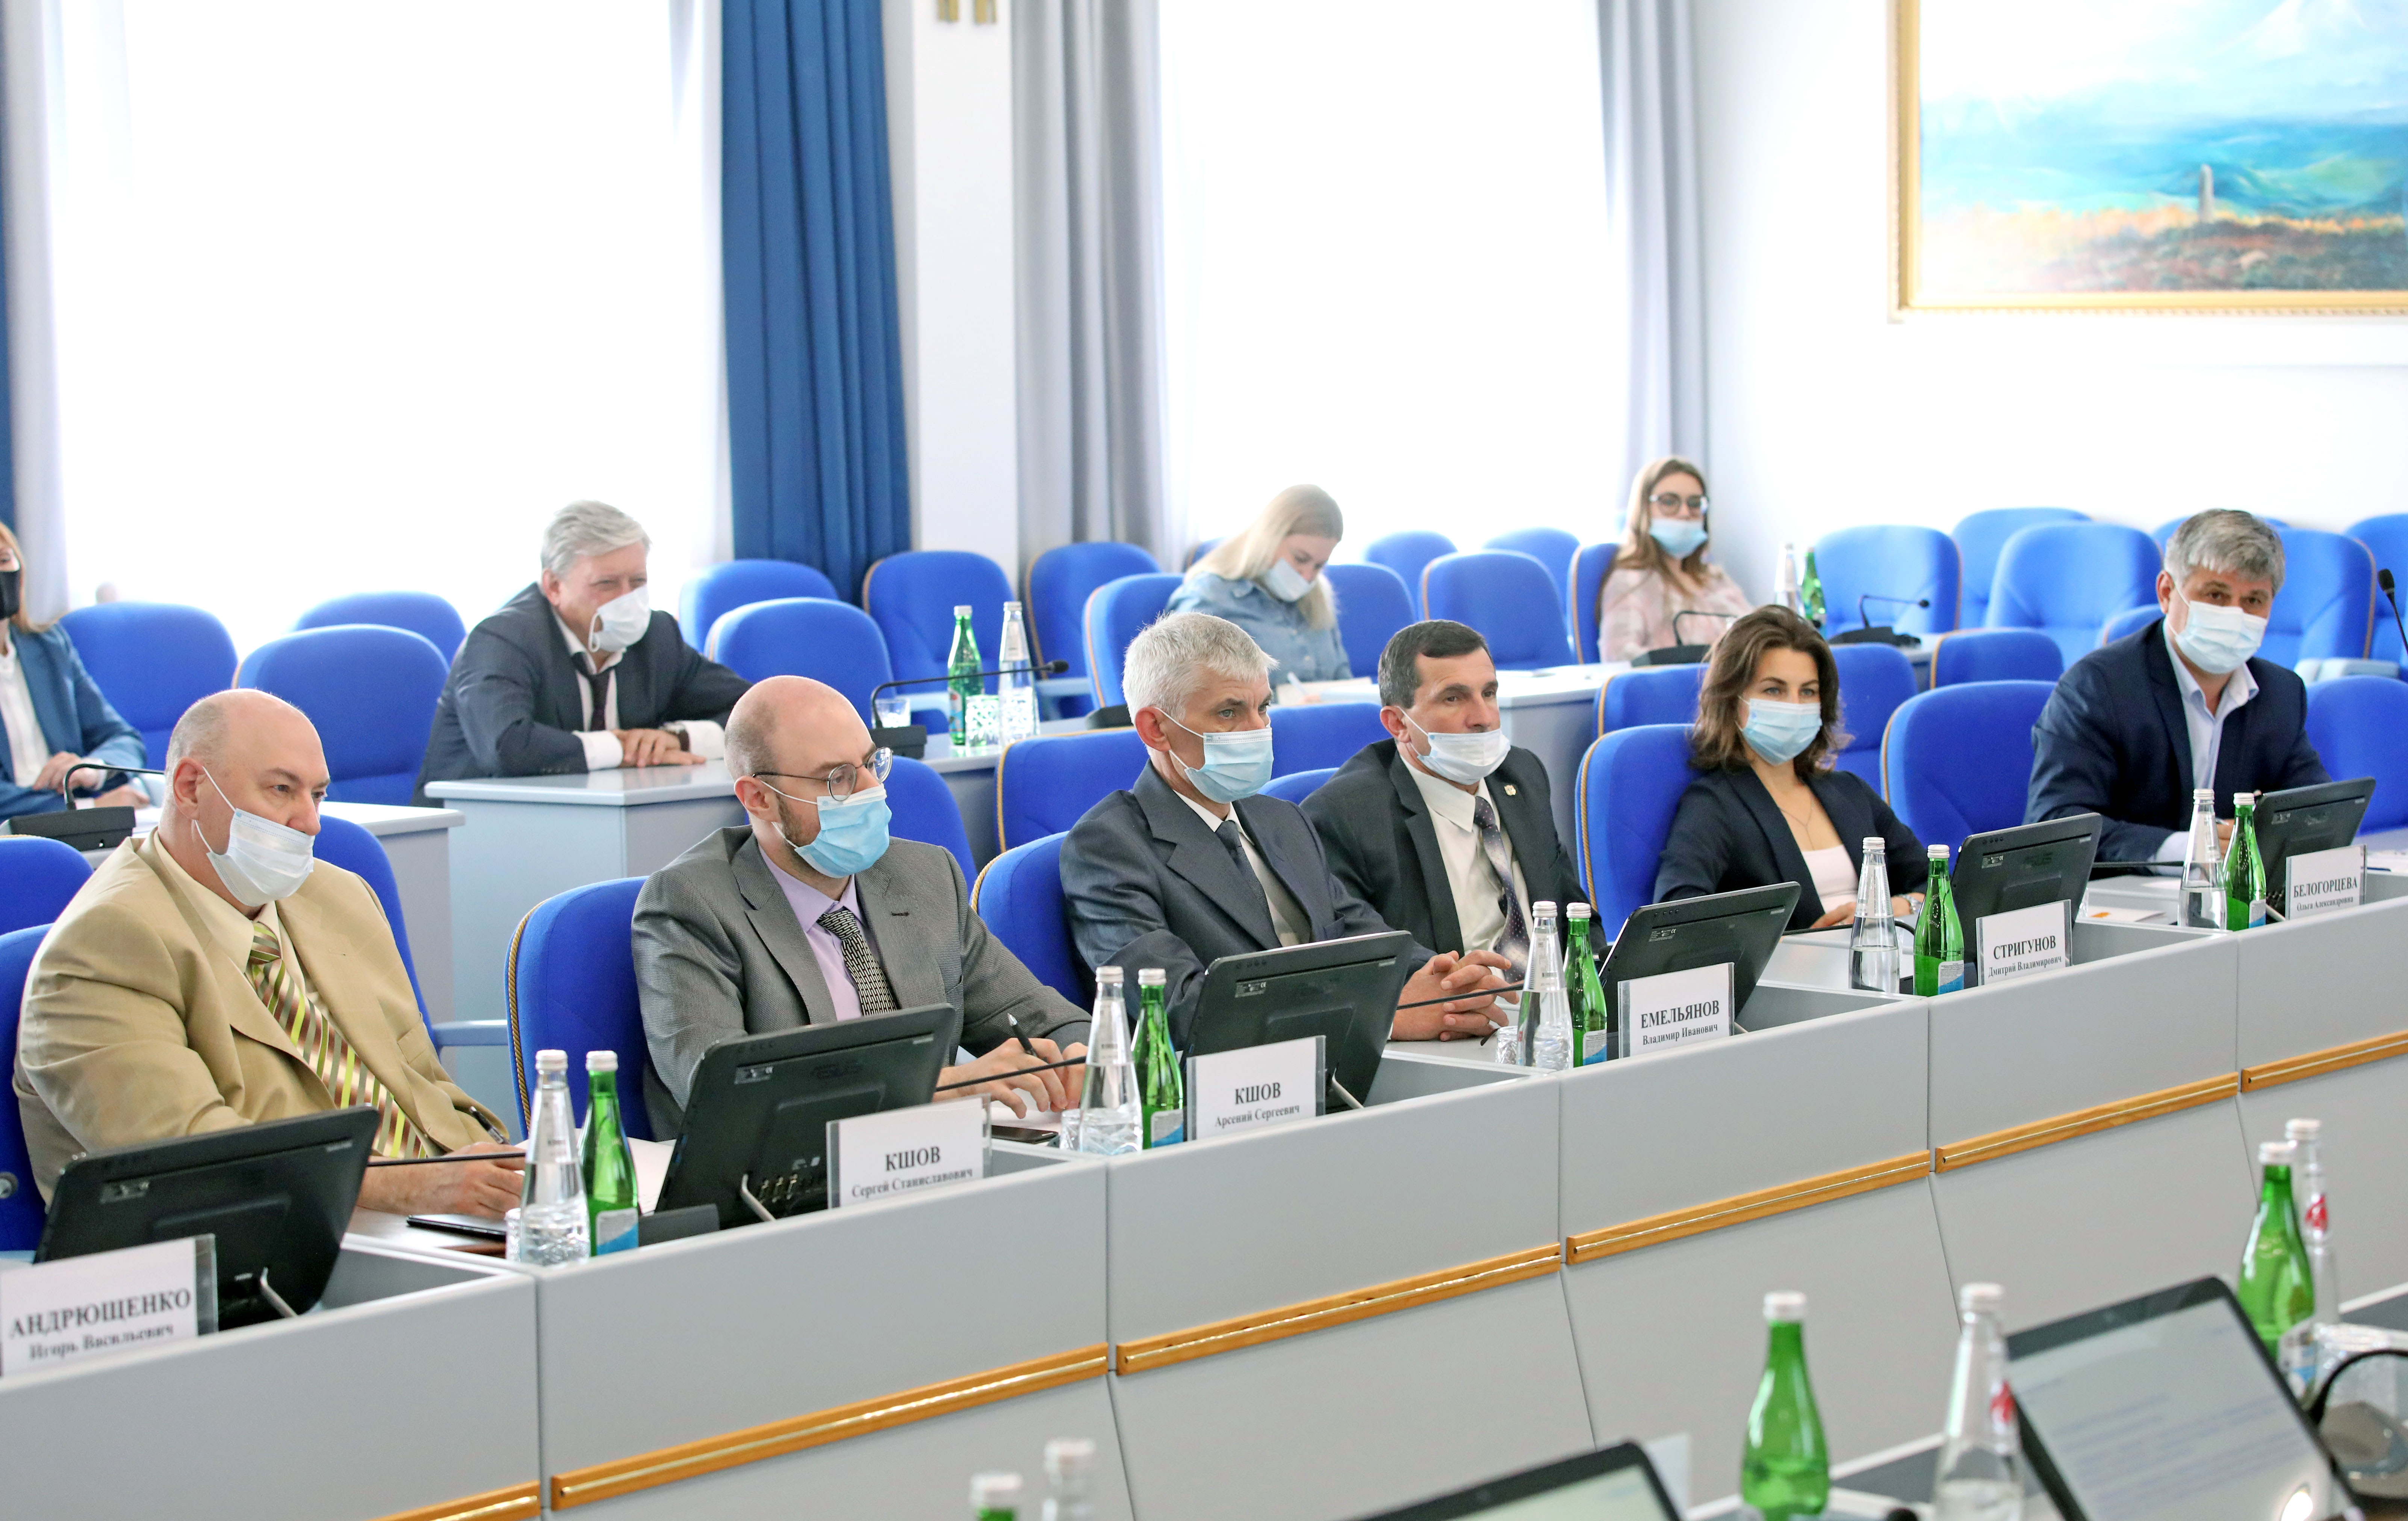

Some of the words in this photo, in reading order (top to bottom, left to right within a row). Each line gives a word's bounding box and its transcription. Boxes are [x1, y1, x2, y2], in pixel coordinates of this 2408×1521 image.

[2293, 877, 2358, 898] БЕЛОГОРЦЕВА
[2297, 902, 2313, 912] Ольга
[2314, 896, 2354, 909] Александровна
[1993, 935, 2056, 960] СТРИГУНОВ
[1988, 963, 2016, 978] Дмитрий
[2018, 956, 2062, 971] Владимирович
[1640, 1000, 1719, 1029] ЕМЕЛЬЯНОВ
[1643, 1031, 1679, 1045] Владимир
[1682, 1024, 1718, 1038] Иванович
[1235, 1082, 1281, 1105] КШОВ
[1215, 1111, 1252, 1128] Арсений
[1254, 1104, 1300, 1121] Сергеевич
[885, 1146, 940, 1172] КШОВ
[852, 1181, 889, 1199] Сергей
[892, 1168, 973, 1191] Станиславович
[9, 1288, 192, 1339] АНДРЮЩЕНКО
[29, 1342, 77, 1360] Игорь
[83, 1323, 174, 1349] Васильевич
